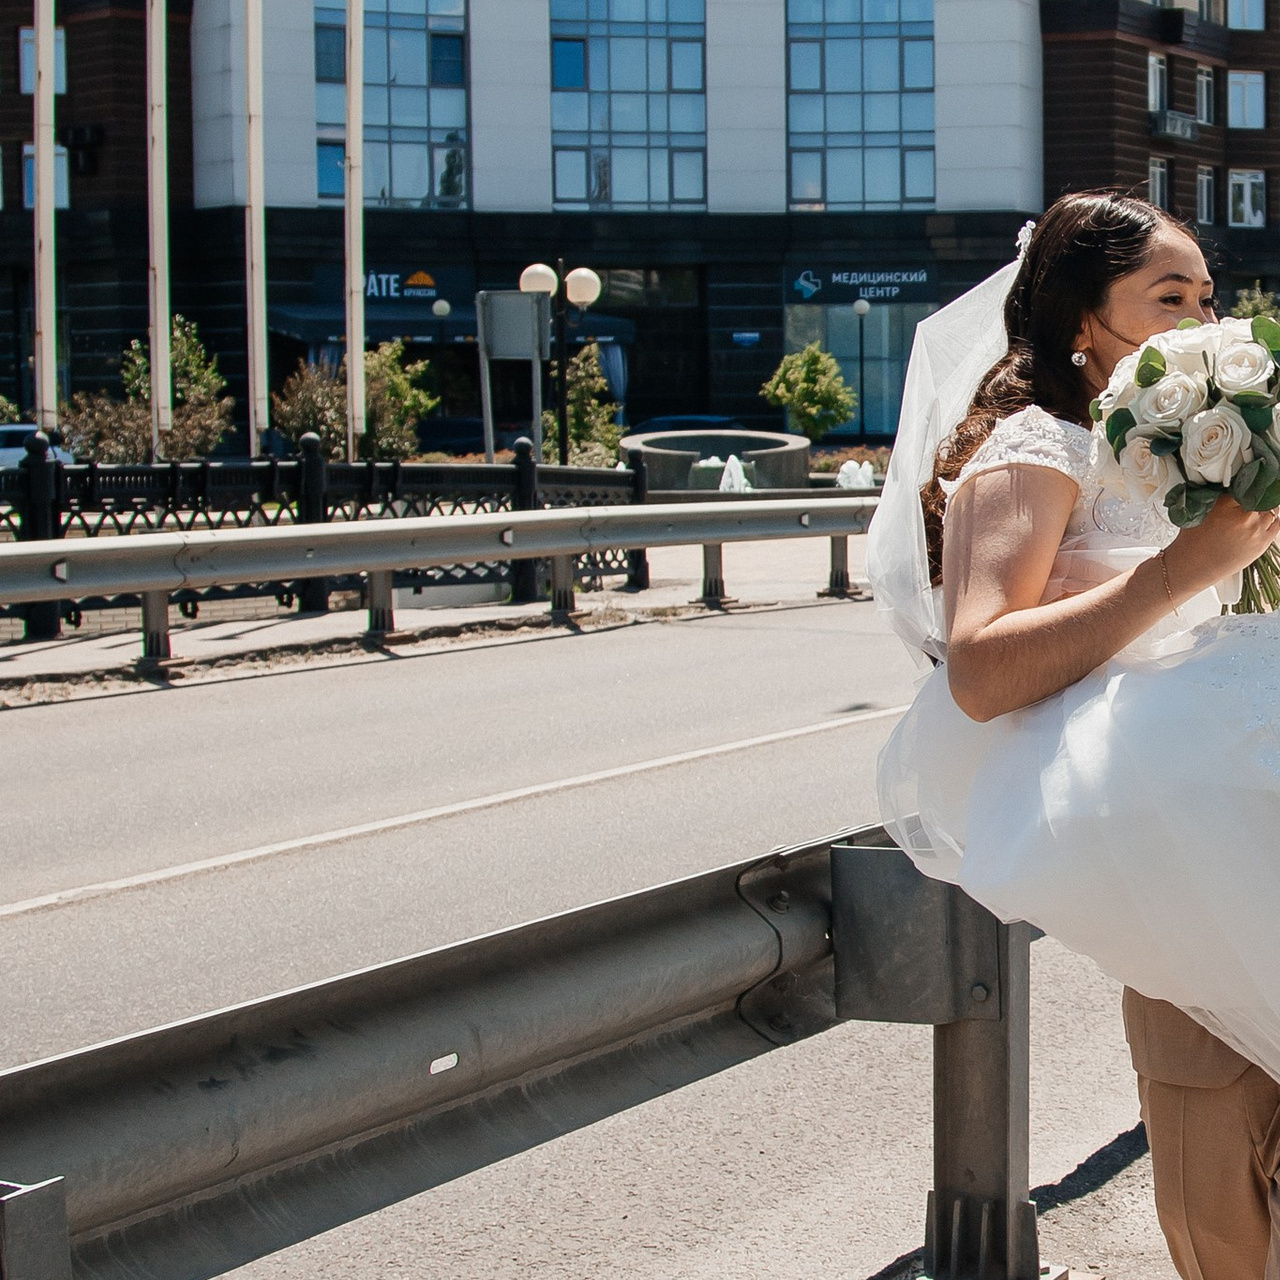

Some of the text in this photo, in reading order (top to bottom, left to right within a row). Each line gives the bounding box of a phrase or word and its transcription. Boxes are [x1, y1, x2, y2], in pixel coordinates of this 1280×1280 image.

[363, 270, 400, 297] ÂTE
[831, 270, 927, 285] МЕДИЦИНСКИЙ
[859, 286, 900, 299] ЦЕНТР
